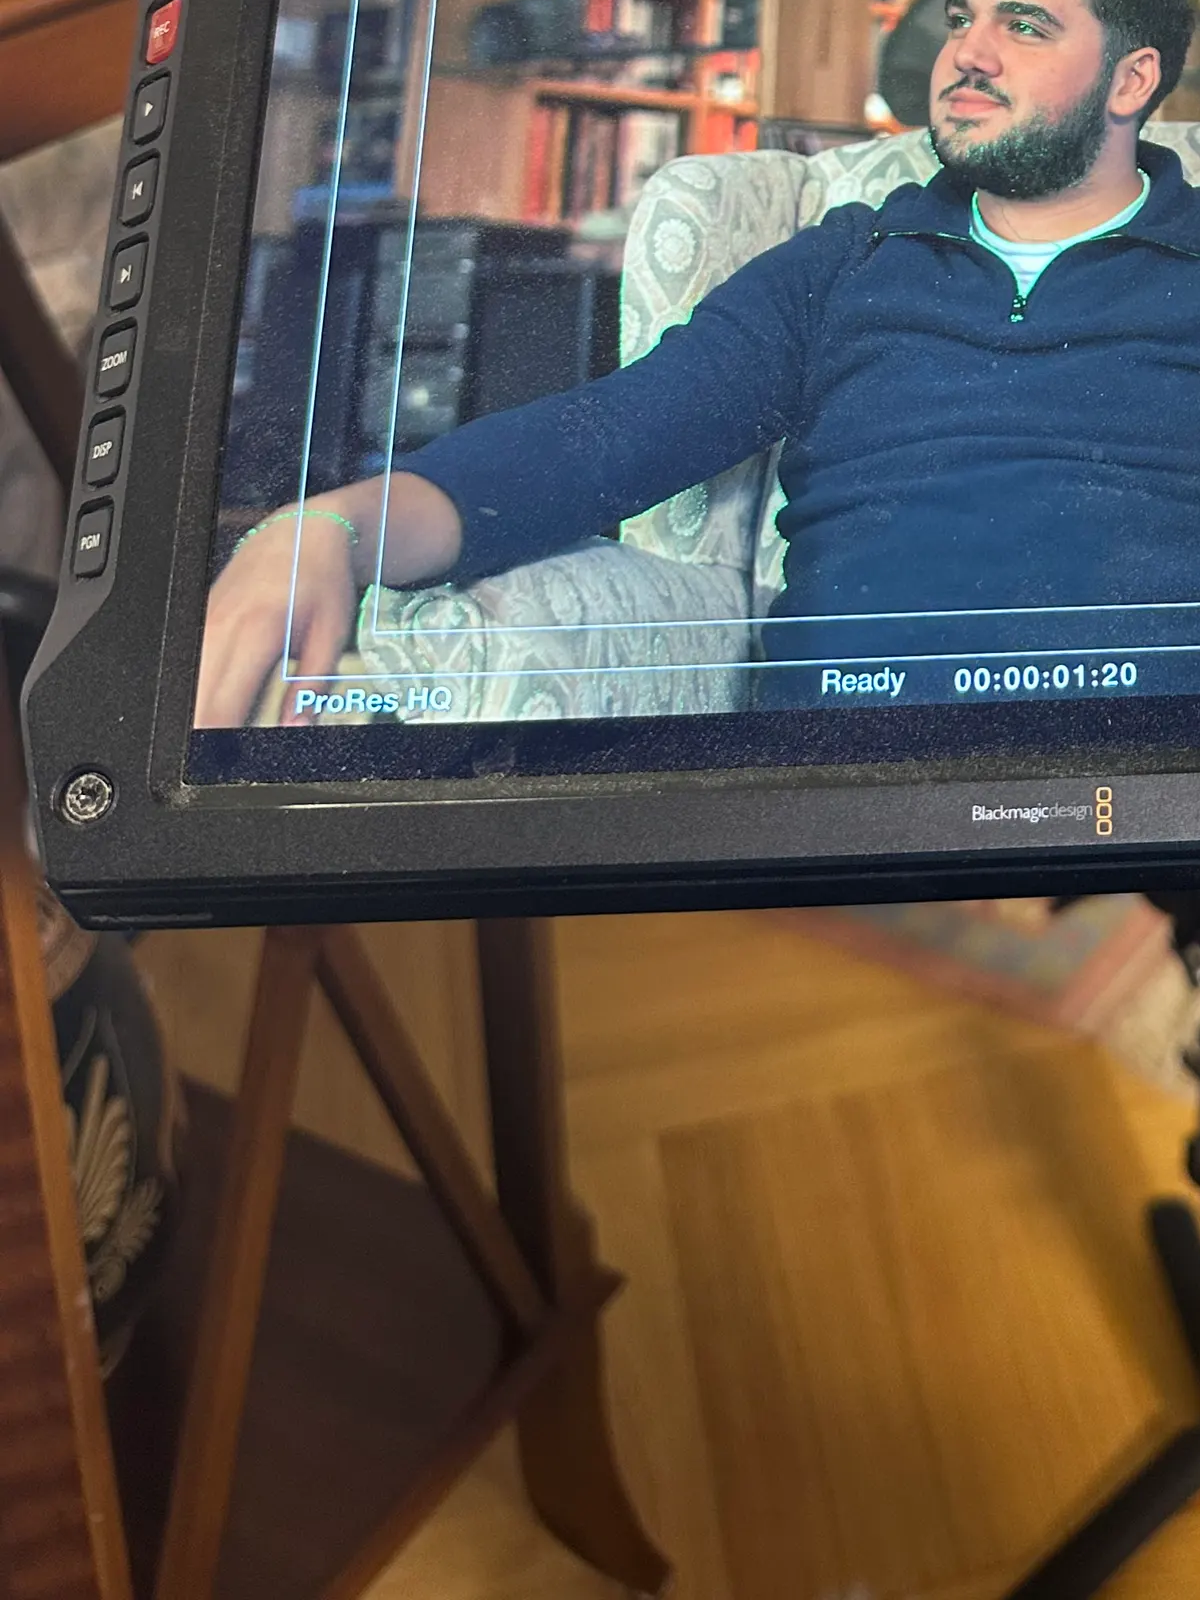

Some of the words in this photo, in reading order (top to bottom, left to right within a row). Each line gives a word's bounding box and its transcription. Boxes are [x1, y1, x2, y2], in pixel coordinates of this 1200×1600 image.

[153, 19, 171, 39] REC
[101, 351, 128, 371] ZOOM
[92, 441, 113, 459] DISP
[80, 533, 101, 550] PGM
[821, 668, 905, 696] Ready
[954, 663, 1137, 692] 00:00:01:20
[296, 689, 399, 714] ProRes
[407, 687, 452, 711] HQ
